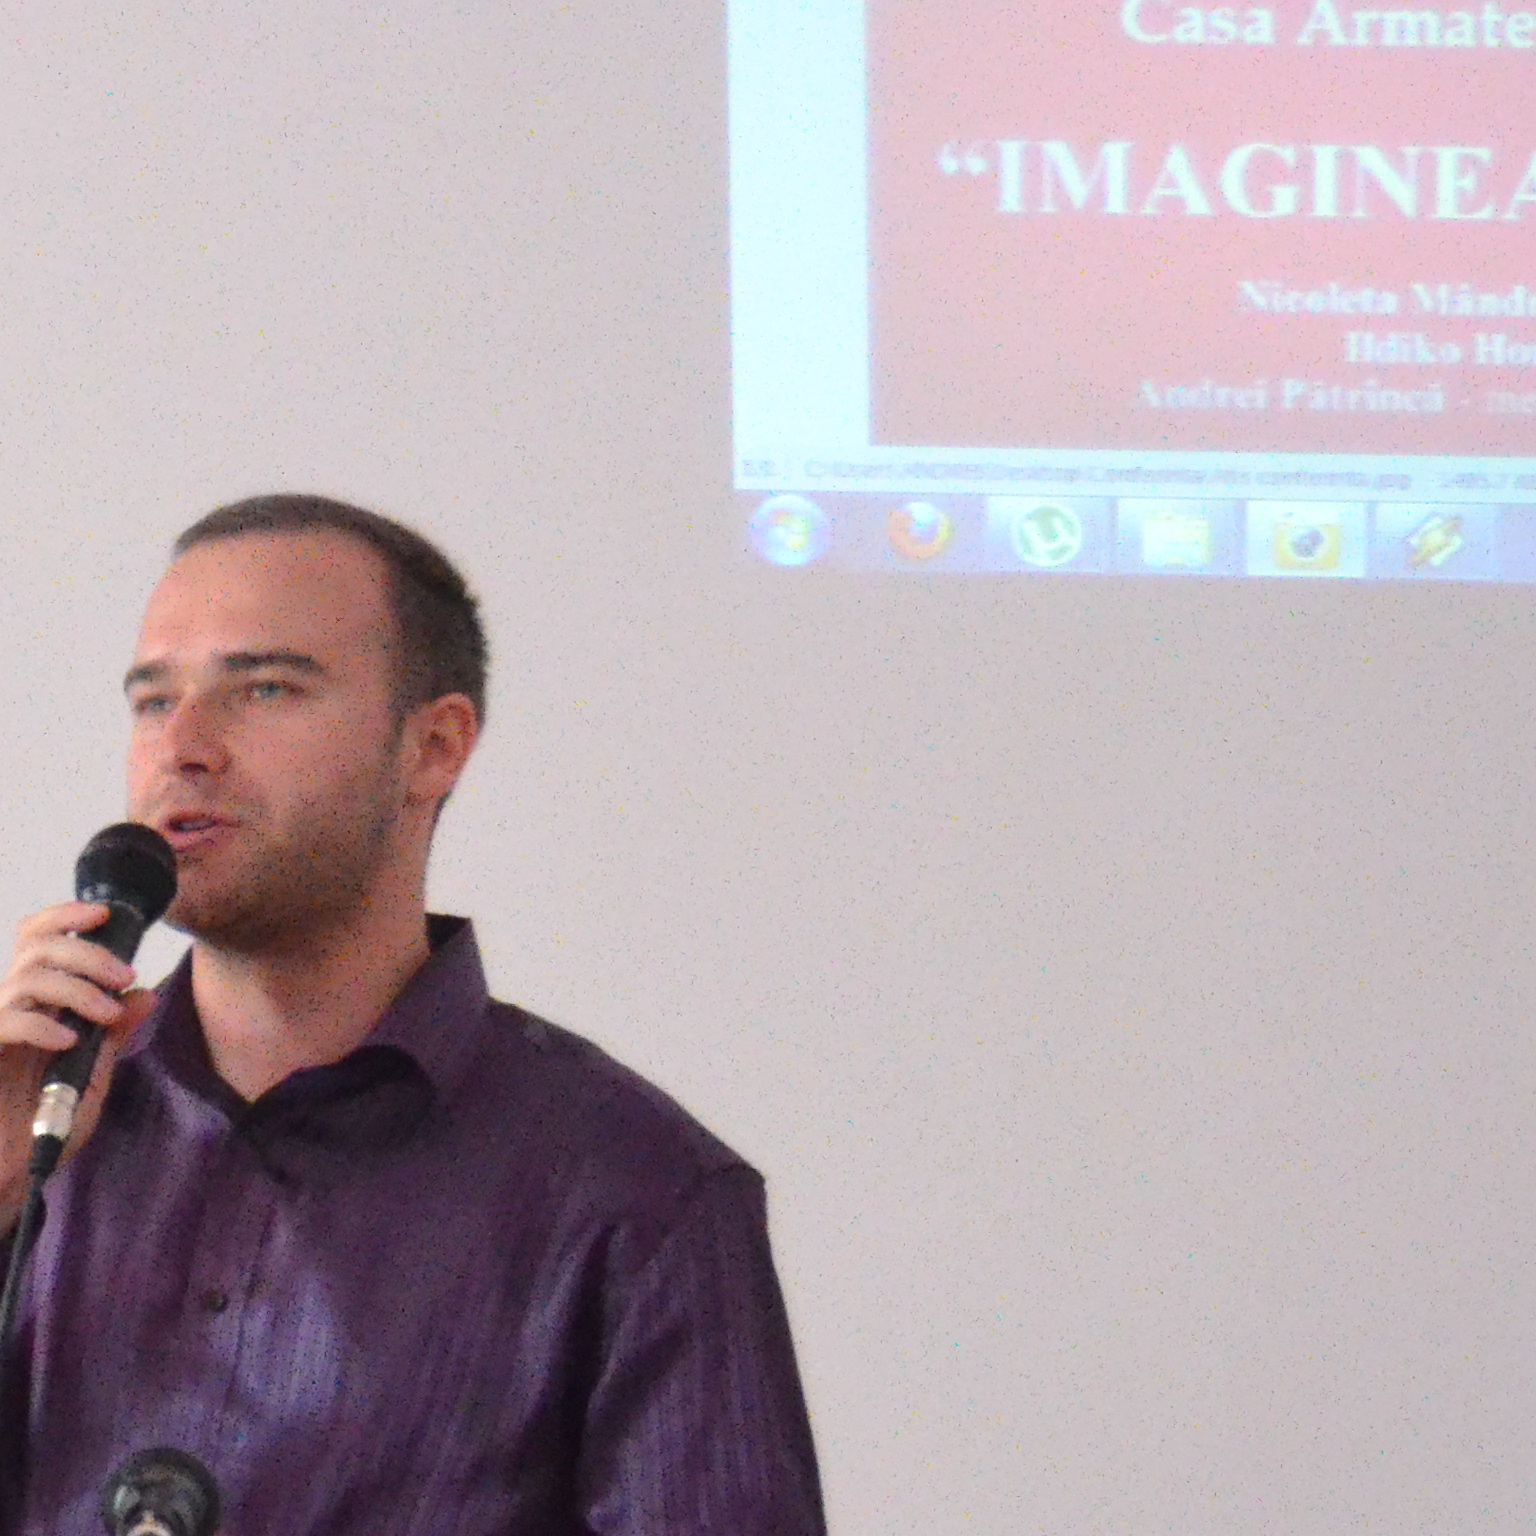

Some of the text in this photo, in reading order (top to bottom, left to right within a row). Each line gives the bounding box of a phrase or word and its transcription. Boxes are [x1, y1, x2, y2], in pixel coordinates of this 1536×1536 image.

[1119, 0, 1275, 45] Casa
[1238, 280, 1398, 315] Nicoleta
[1130, 377, 1267, 410] Andrei
